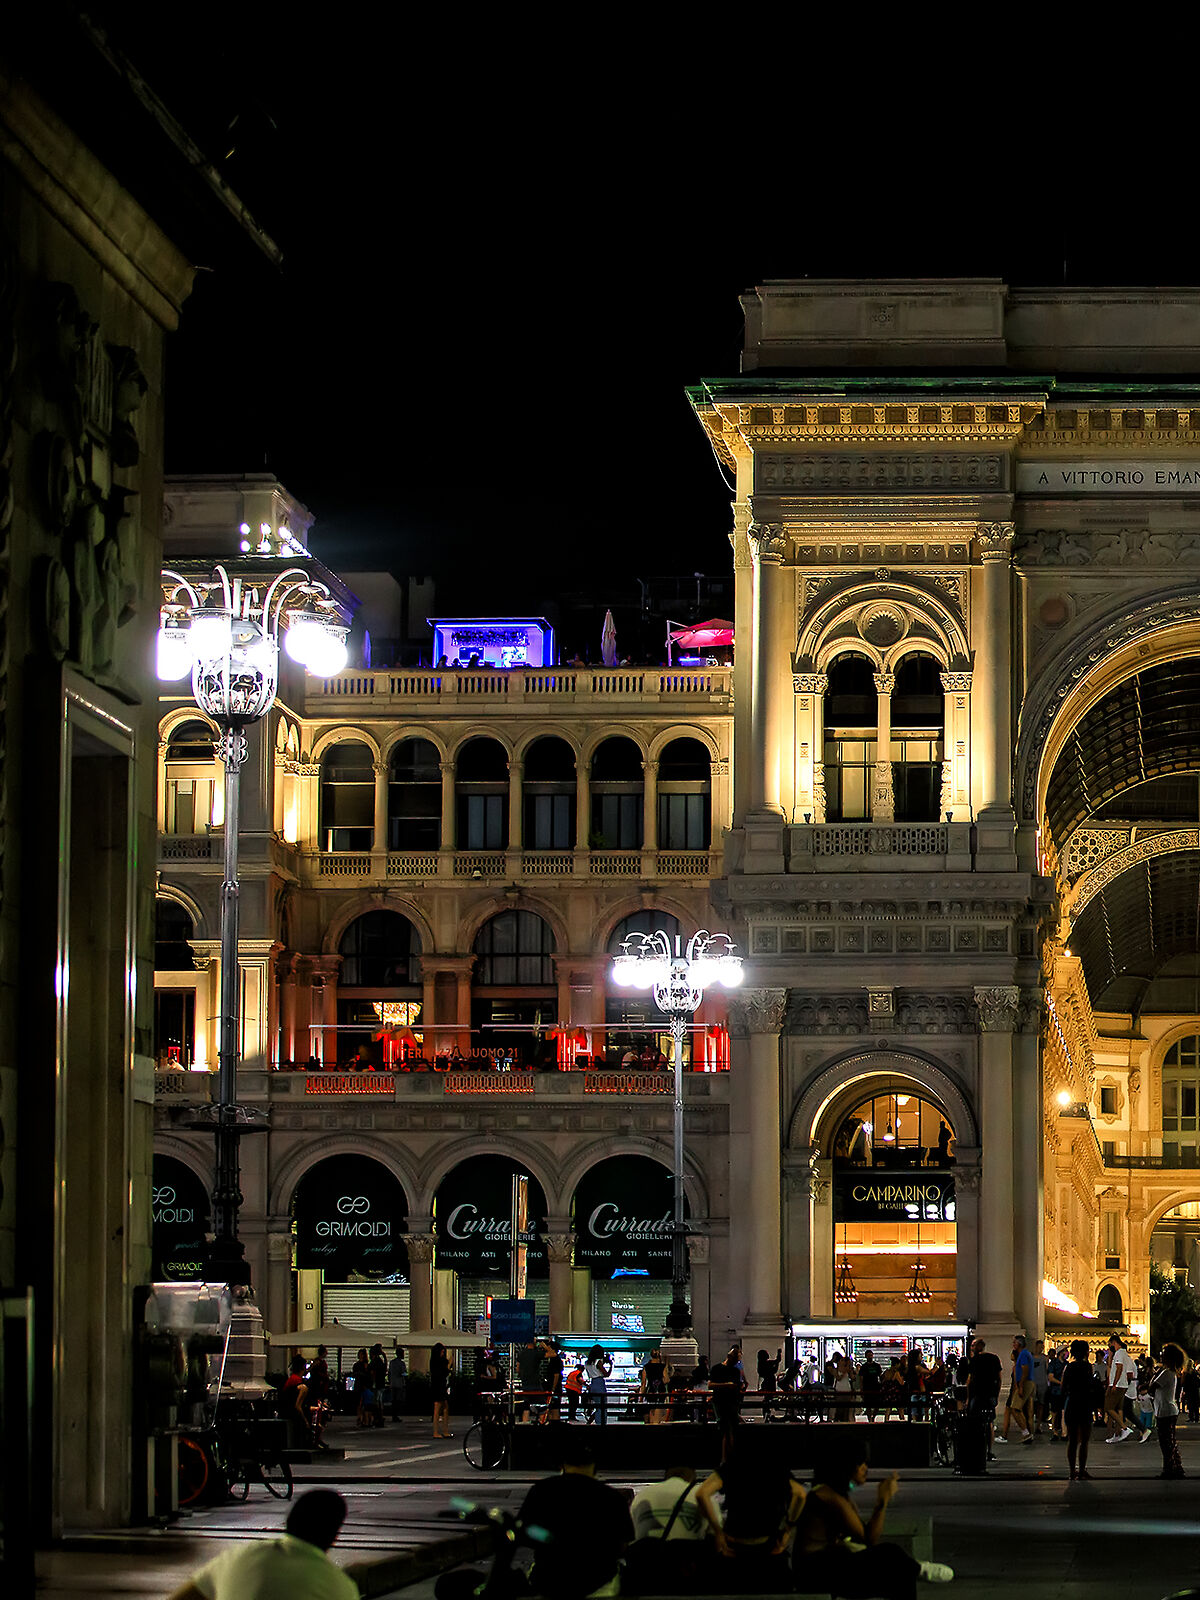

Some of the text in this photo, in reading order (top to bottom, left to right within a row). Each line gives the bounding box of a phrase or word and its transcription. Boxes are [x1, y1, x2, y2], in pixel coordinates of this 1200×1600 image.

[1038, 471, 1049, 484] A
[1061, 471, 1145, 484] VITTORIO
[508, 1047, 519, 1058] 21
[852, 1185, 941, 1202] CAMPARINO
[315, 1221, 391, 1237] GRIMOLDI
[484, 1233, 536, 1241] GIOIELERIE
[625, 1232, 673, 1240] GIOIELLERI
